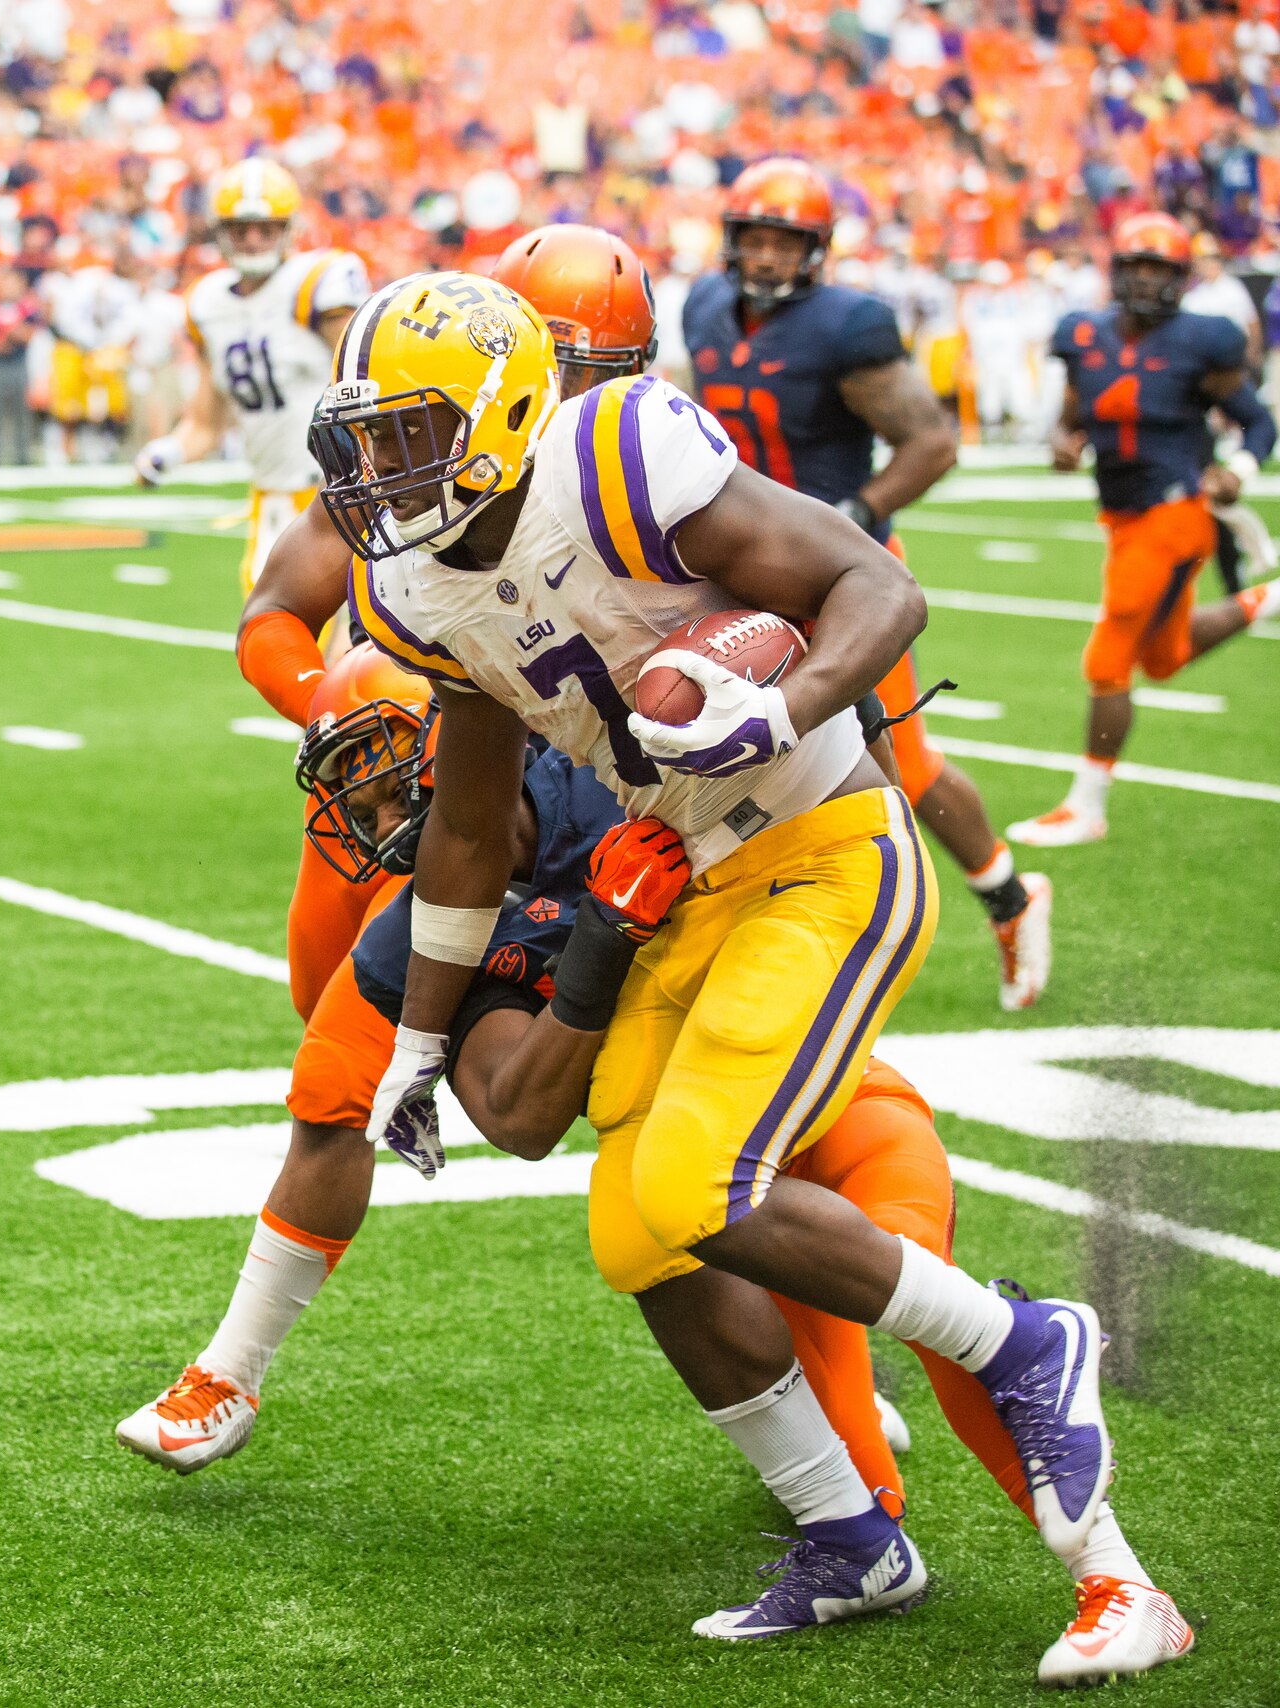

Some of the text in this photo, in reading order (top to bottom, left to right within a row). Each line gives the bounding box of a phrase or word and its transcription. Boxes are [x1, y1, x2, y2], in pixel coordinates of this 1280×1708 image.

[225, 337, 286, 413] 81
[666, 396, 728, 457] 7
[1093, 373, 1141, 461] 4
[516, 619, 556, 651] LSU
[516, 632, 664, 788] 7
[860, 1538, 906, 1605] NIKE
